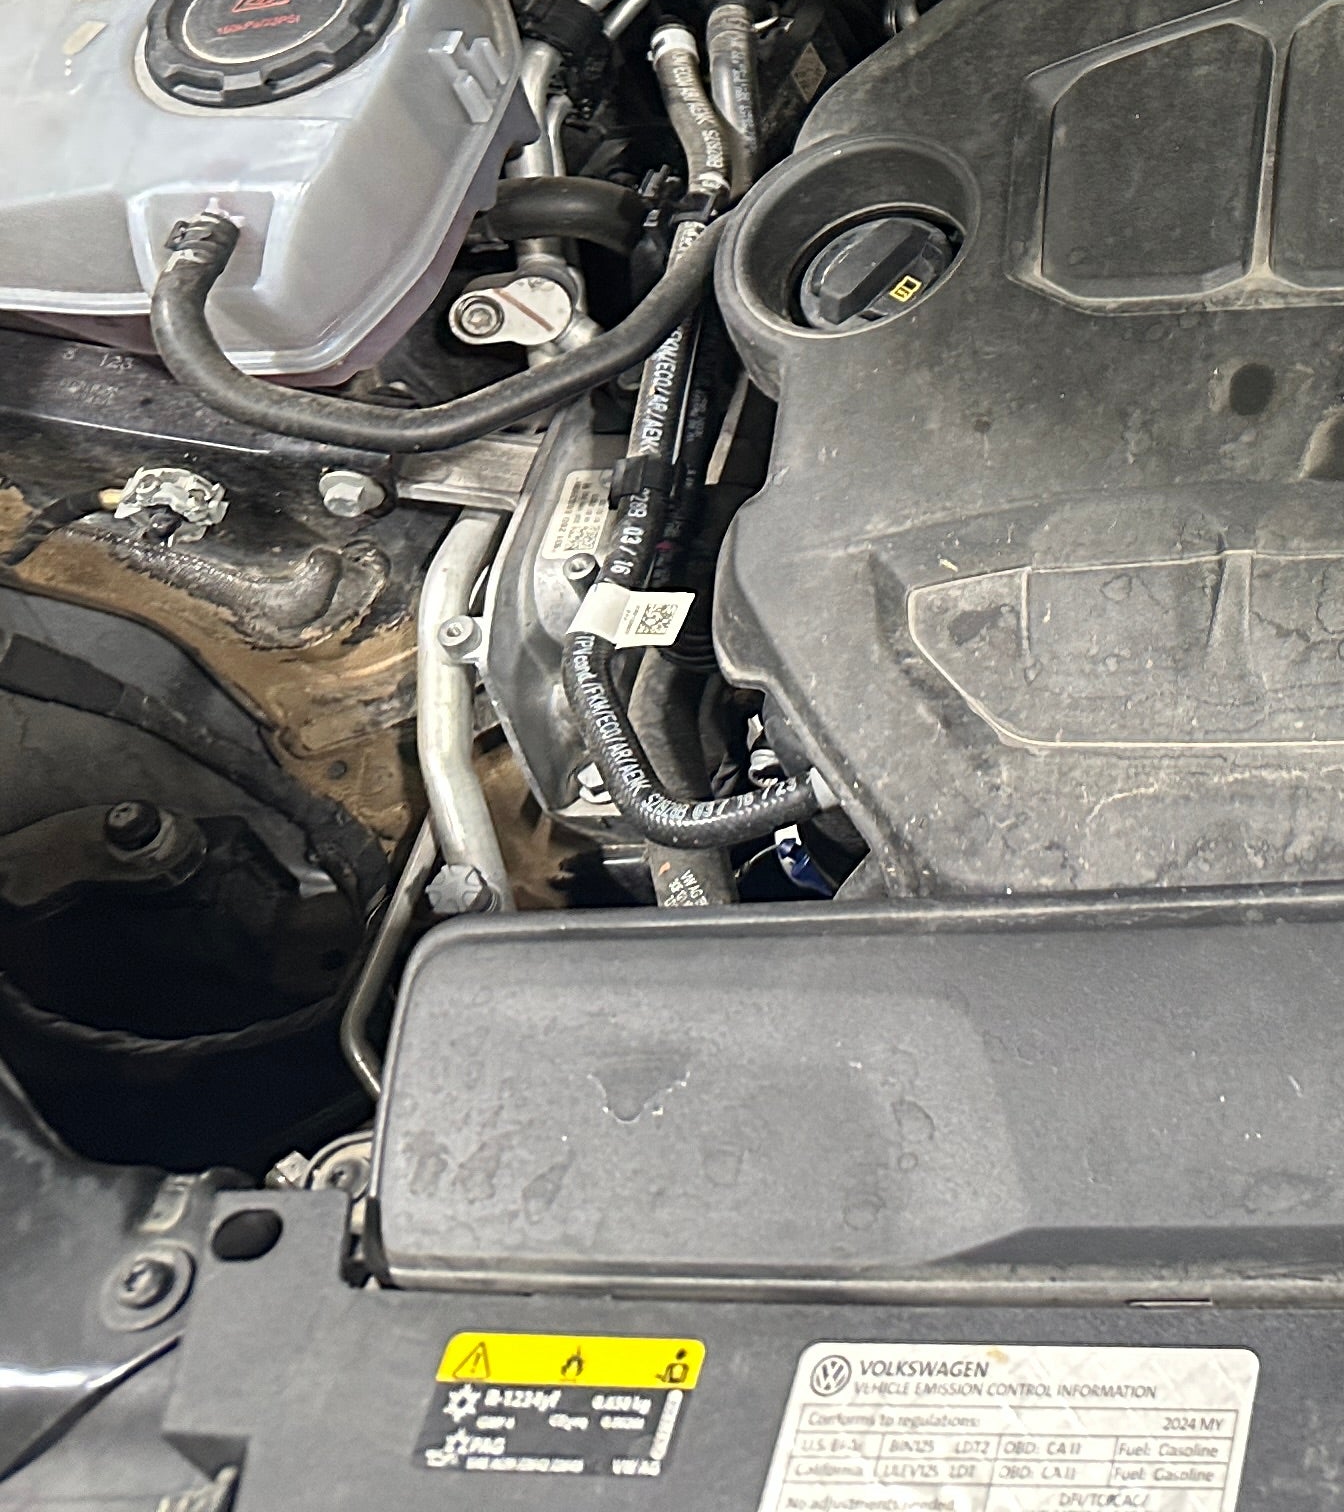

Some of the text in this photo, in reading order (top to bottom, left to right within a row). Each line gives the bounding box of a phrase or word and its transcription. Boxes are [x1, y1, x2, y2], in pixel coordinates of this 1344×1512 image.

[860, 1360, 990, 1378] VOLKSWAGEN
[854, 1381, 1157, 1399] VEHICLE EMISSION CONTROL INFORMATION
[880, 1412, 894, 1426] to
[1162, 1416, 1225, 1431] 2024 MY
[1118, 1443, 1219, 1458] Fuel: Gasoline
[1152, 1467, 1214, 1482] Gasoline
